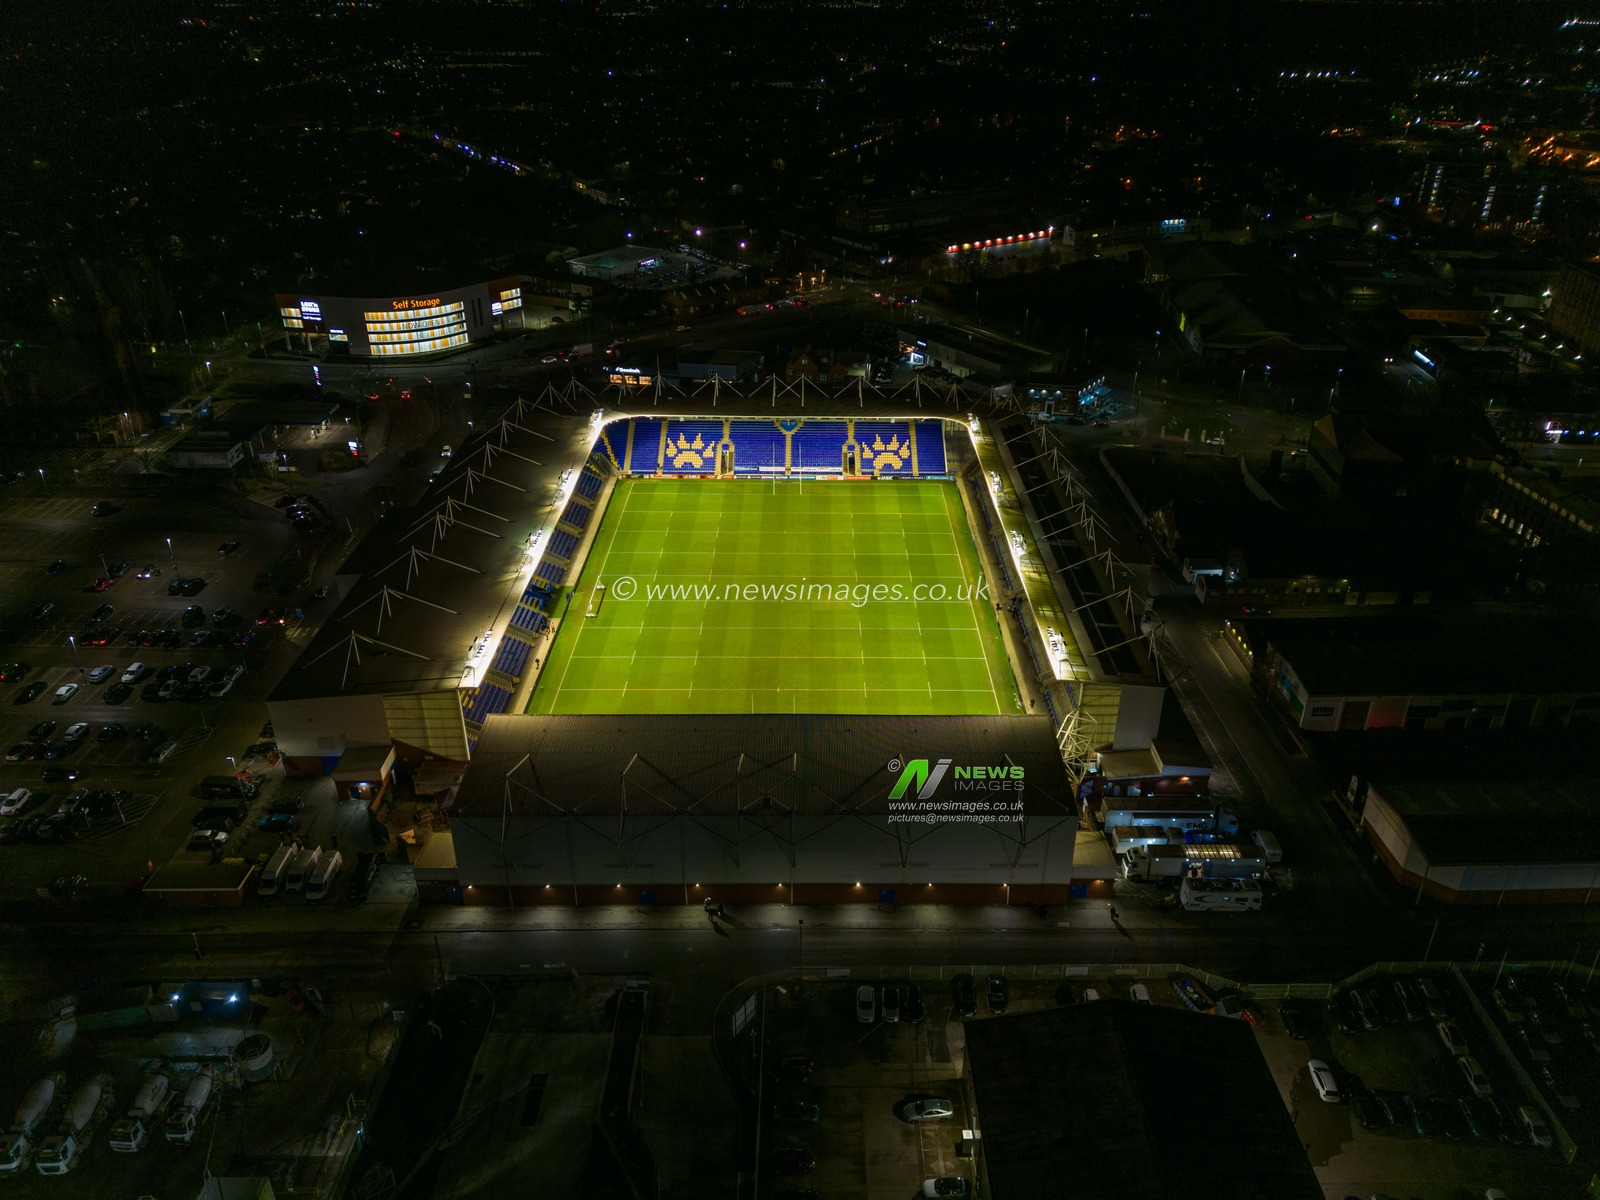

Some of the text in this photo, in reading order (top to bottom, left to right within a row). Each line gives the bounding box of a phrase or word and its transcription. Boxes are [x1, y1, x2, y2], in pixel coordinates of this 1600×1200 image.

[392, 297, 441, 310] Self Storage
[402, 318, 440, 330] NOW OPEN
